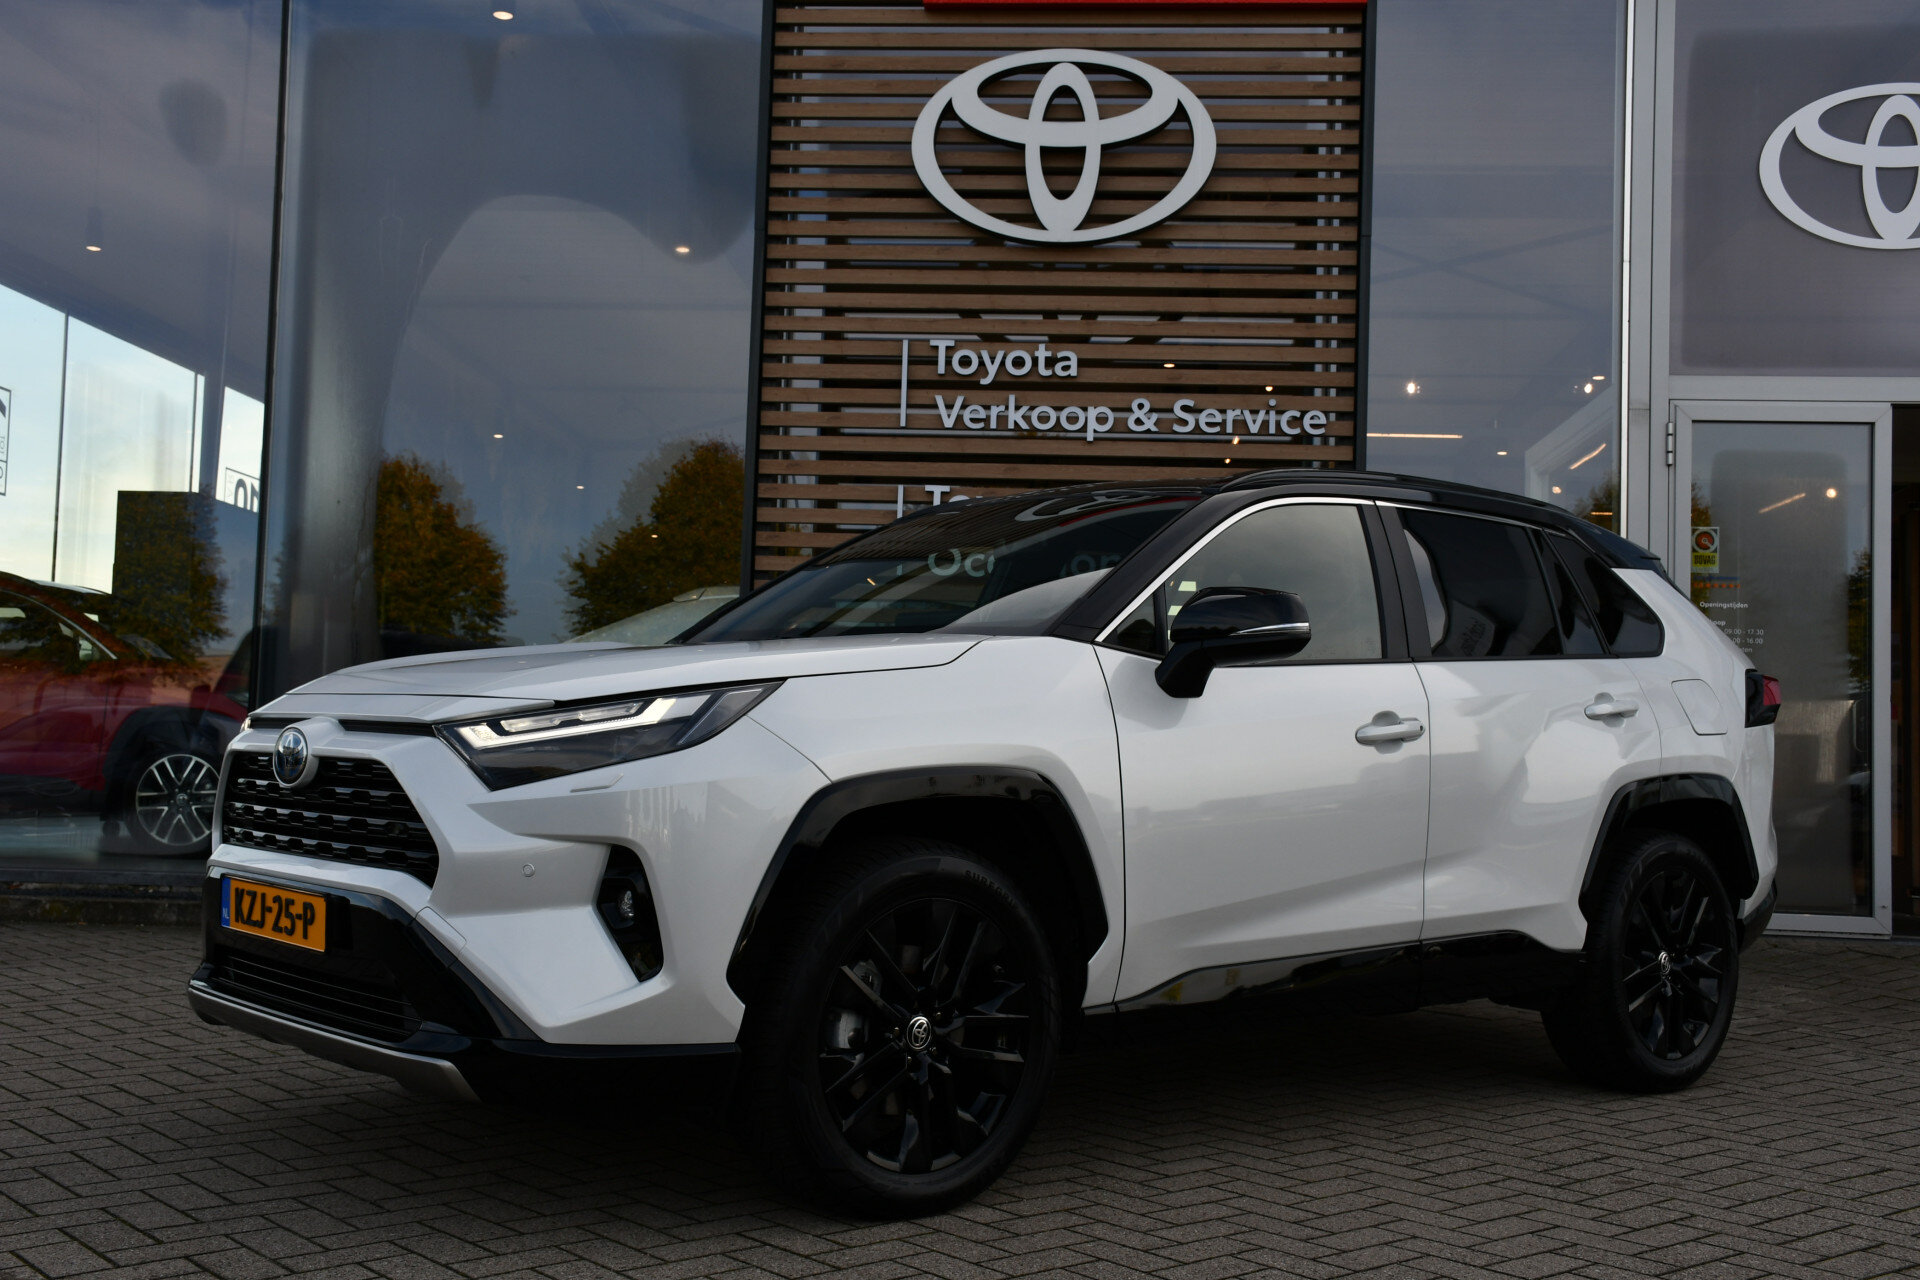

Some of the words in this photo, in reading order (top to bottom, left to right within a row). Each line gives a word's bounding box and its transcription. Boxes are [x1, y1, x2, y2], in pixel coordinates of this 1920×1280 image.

[930, 340, 1078, 385] Toyota
[934, 394, 1115, 442] Verkoop
[1127, 398, 1159, 432] &
[1172, 398, 1328, 435] Service
[1699, 602, 1749, 610] Openingstijden
[234, 887, 316, 940] KZJ-25-P
